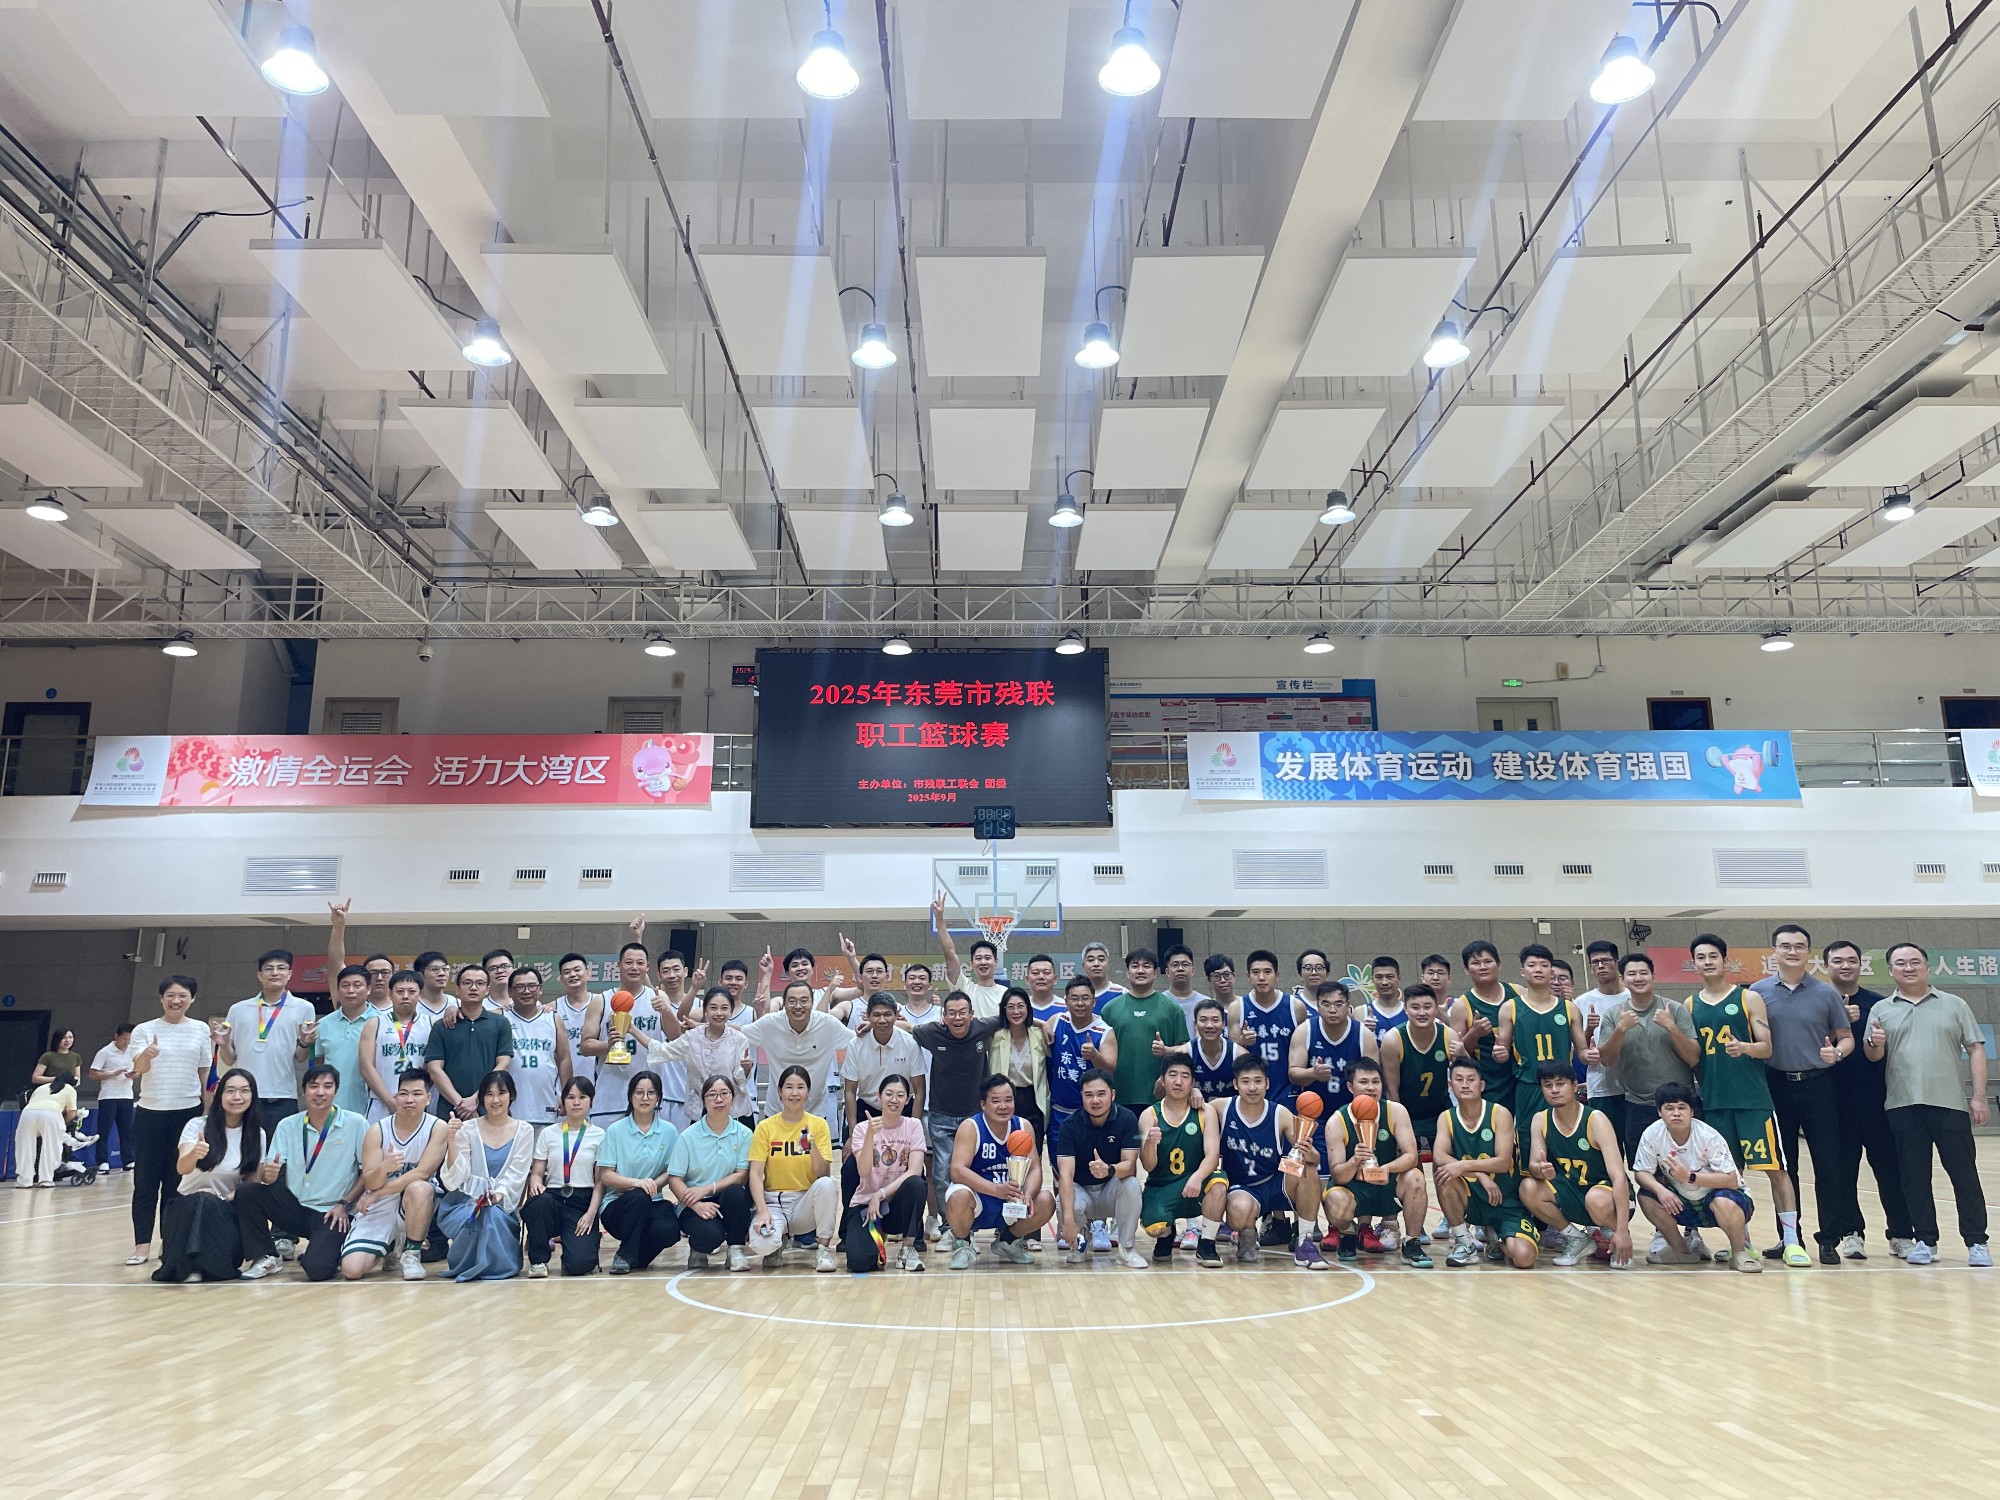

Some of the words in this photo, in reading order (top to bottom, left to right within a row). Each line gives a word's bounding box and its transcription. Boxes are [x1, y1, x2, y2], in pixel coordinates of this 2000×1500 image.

[810, 680, 1055, 707] 2025年东莞市残联
[1276, 680, 1314, 691] 宣传栏
[856, 721, 1010, 748] 职工篮球赛
[223, 754, 413, 787] 激情全运会
[428, 754, 610, 786] 活力大湾区
[1275, 751, 1473, 782] 发展体育运动
[1492, 750, 1692, 782] 建设体育强国
[907, 792, 957, 803] 2025年9月
[1535, 1033, 1555, 1061] 11
[1700, 1024, 1731, 1056] 24
[520, 1055, 539, 1068] 18
[1260, 1042, 1280, 1062] 15
[1328, 1076, 1341, 1093] 6
[1420, 1072, 1434, 1097] 7
[771, 1141, 811, 1157] FIL
[981, 1142, 997, 1160] 88
[1740, 1138, 1768, 1160] 24
[1169, 1147, 1185, 1175] 8
[1243, 1157, 1258, 1177] 7
[1557, 1157, 1588, 1186] 77
